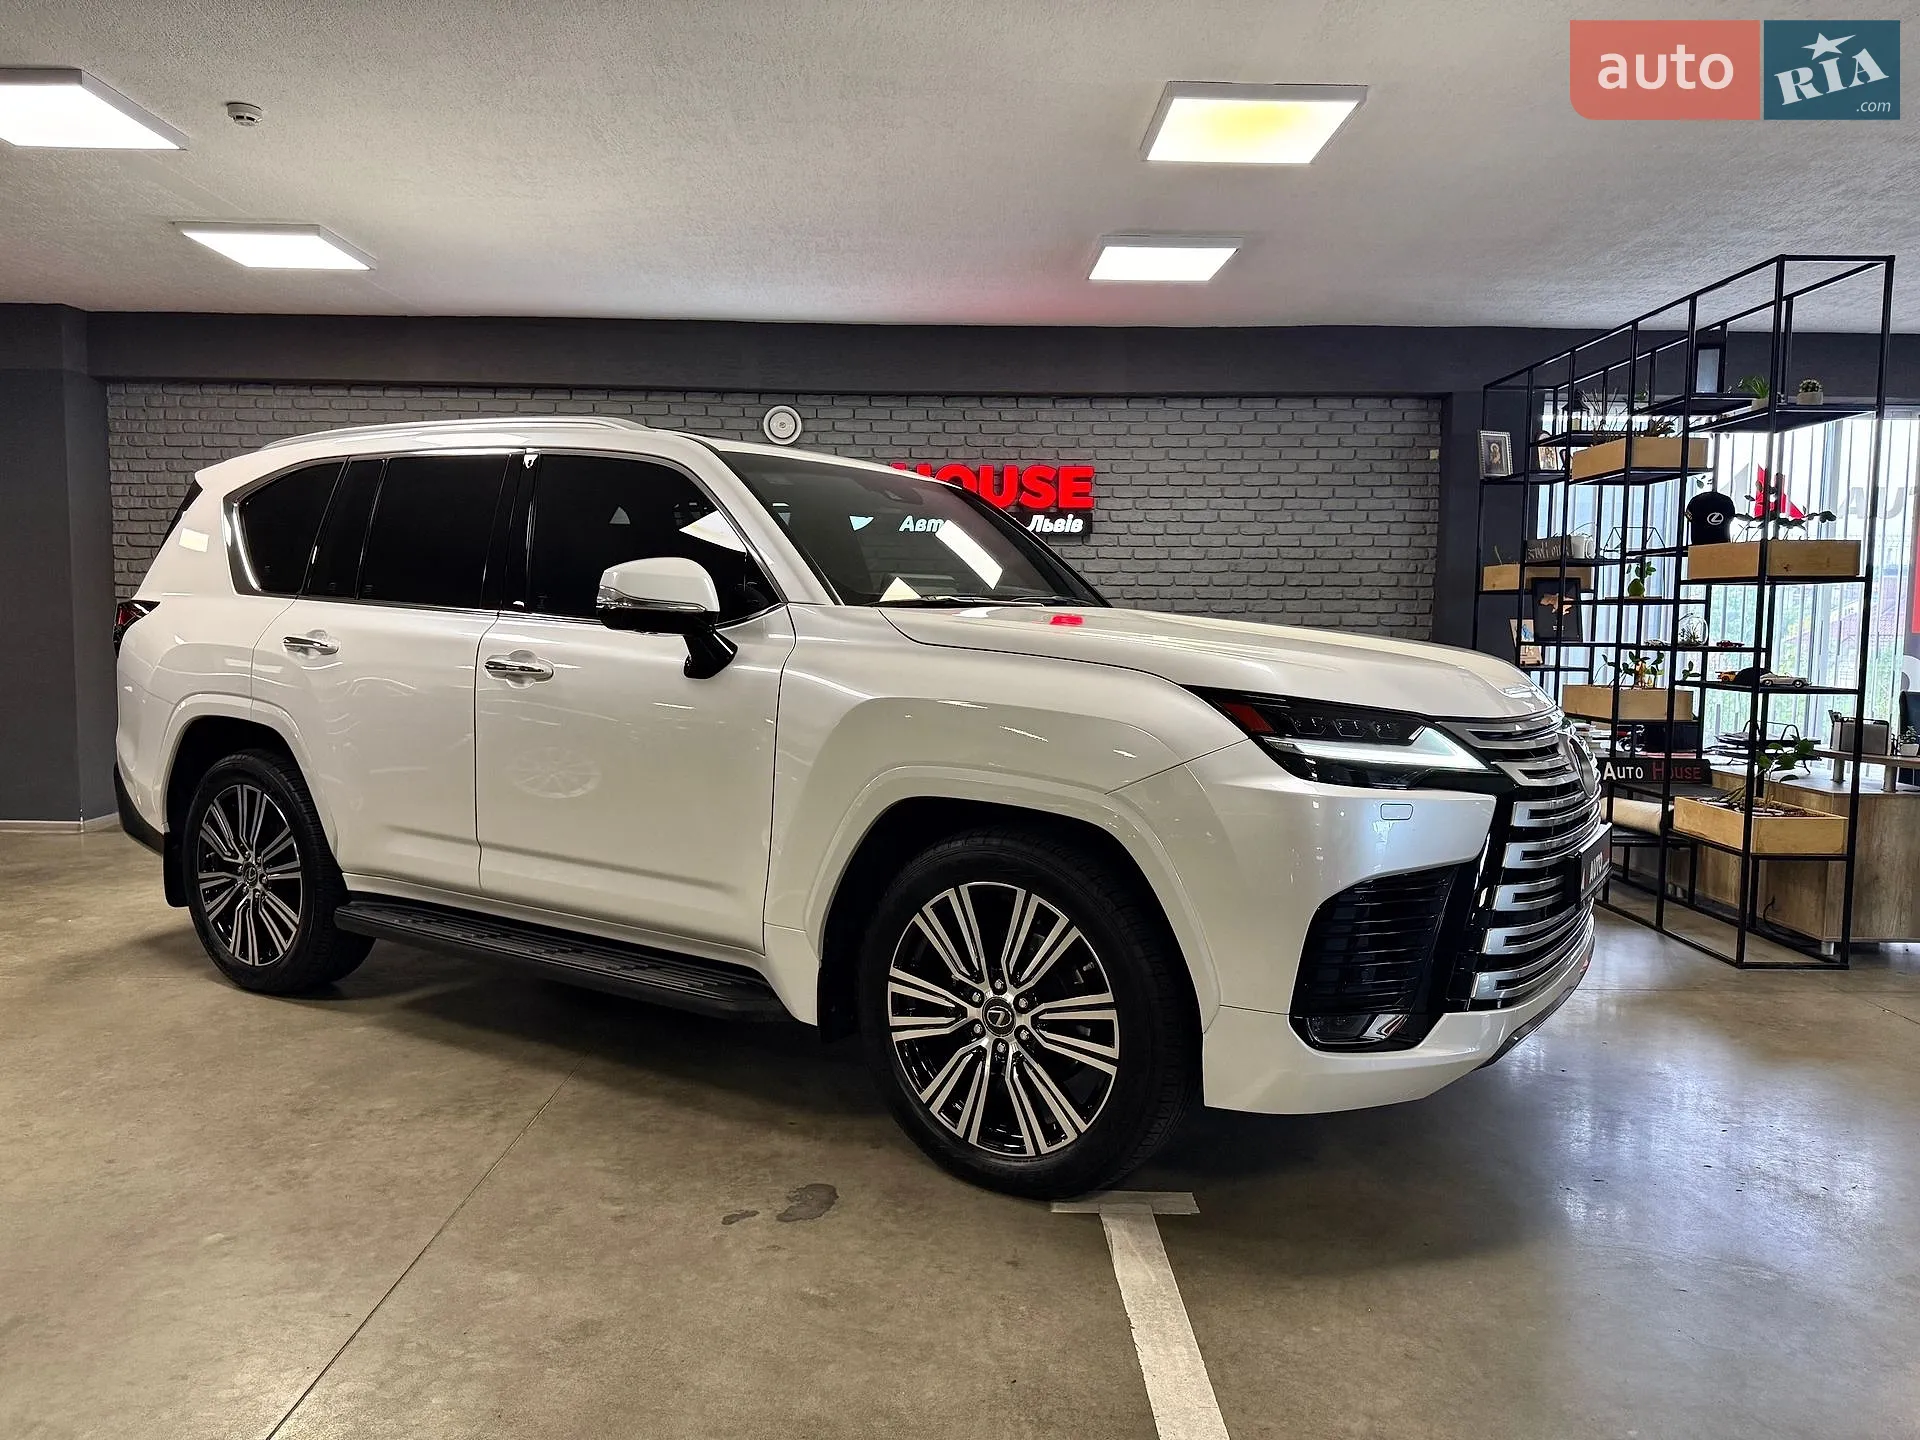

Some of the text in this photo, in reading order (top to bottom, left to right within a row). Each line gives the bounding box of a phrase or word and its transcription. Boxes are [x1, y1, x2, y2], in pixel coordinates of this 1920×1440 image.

[891, 463, 1095, 509] OUSE
[1027, 514, 1083, 533] Львів
[1652, 760, 1700, 779] HUSE
